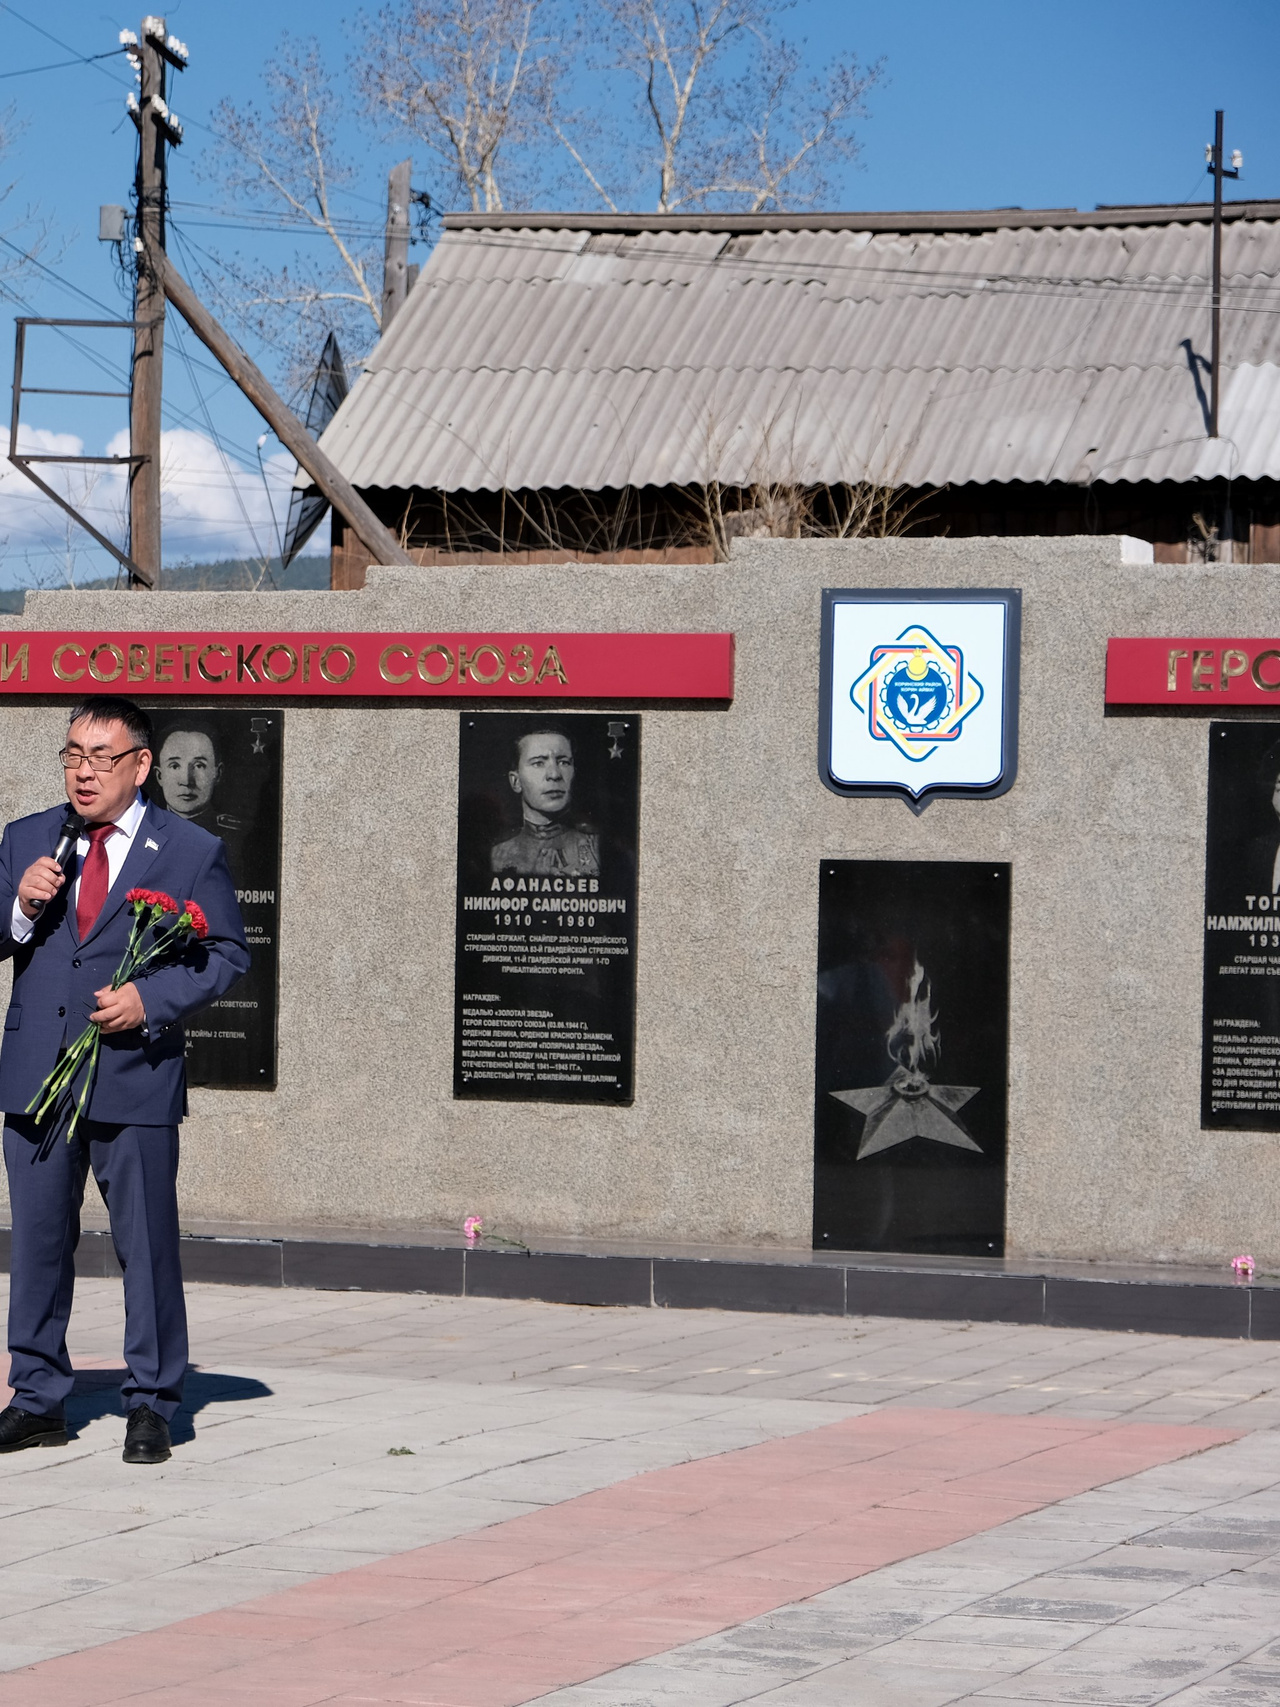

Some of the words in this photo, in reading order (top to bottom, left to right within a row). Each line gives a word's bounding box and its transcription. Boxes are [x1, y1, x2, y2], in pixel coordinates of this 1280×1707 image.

[51, 643, 358, 685] СОВЕТСКОГО
[379, 643, 569, 687] СОЮЗА
[1167, 650, 1280, 692] ГЕРО
[491, 877, 600, 892] АФАНАСЬЕВ
[235, 890, 275, 903] РОВИЧ
[464, 897, 528, 911] НИКИФОР
[532, 898, 626, 913] САМСОНОВИЧ
[495, 914, 532, 926] 1910
[557, 916, 595, 927] 1980
[467, 933, 495, 941] СТАРШИЙ
[529, 934, 558, 942] СНАЙПЕР
[580, 936, 627, 945] ГВАРДЕЙСКОГО
[1249, 934, 1279, 947] 193
[544, 946, 587, 954] ГВАРДЕЙСКОЙ
[588, 947, 629, 955] СТРЕЛКОВОЙ
[463, 994, 501, 1002] НАГРАЖДЕН:
[495, 1009, 525, 1017] «ЗОЛОТАЯ
[527, 1010, 553, 1018] ЗВЕЗДА»
[483, 1020, 523, 1028] СОВЕТСКОГО
[1213, 1019, 1260, 1028] НАГРАЖДЕНА:
[191, 1029, 213, 1037] ВОЙНЫ
[218, 1031, 246, 1039] СТЕПЕНИ,
[463, 1030, 491, 1038] ОРДЕНОМ
[520, 1031, 549, 1039] ОРДЕНОМ
[550, 1032, 582, 1040] КРАСНОГО
[583, 1033, 614, 1041] ЗНАМЕНИ,
[462, 1040, 507, 1048] МОНГОЛЬСКИМ
[508, 1041, 537, 1049] ОРДЕНОМ
[539, 1042, 575, 1050] «ПОЛЯРНАЯ
[576, 1043, 604, 1051] ЗВЕЗДА»,
[462, 1050, 496, 1058] МЕДАЛЯМИ
[510, 1051, 533, 1059] ПОБЕДУ
[549, 1052, 585, 1060] ГЕРМАНИЕЙ
[592, 1053, 621, 1062] ВЕЛИКОЙ
[462, 1060, 513, 1069] ОТЕЧЕСТВЕННОЙ
[515, 1061, 535, 1069] ВОЙНЕ
[474, 1071, 515, 1080] ДОБЛЕСТНЫЙ
[537, 1073, 581, 1082] ЮБИЛЕЙНЫМИ
[583, 1075, 617, 1083] МЕДАЛЯМИ
